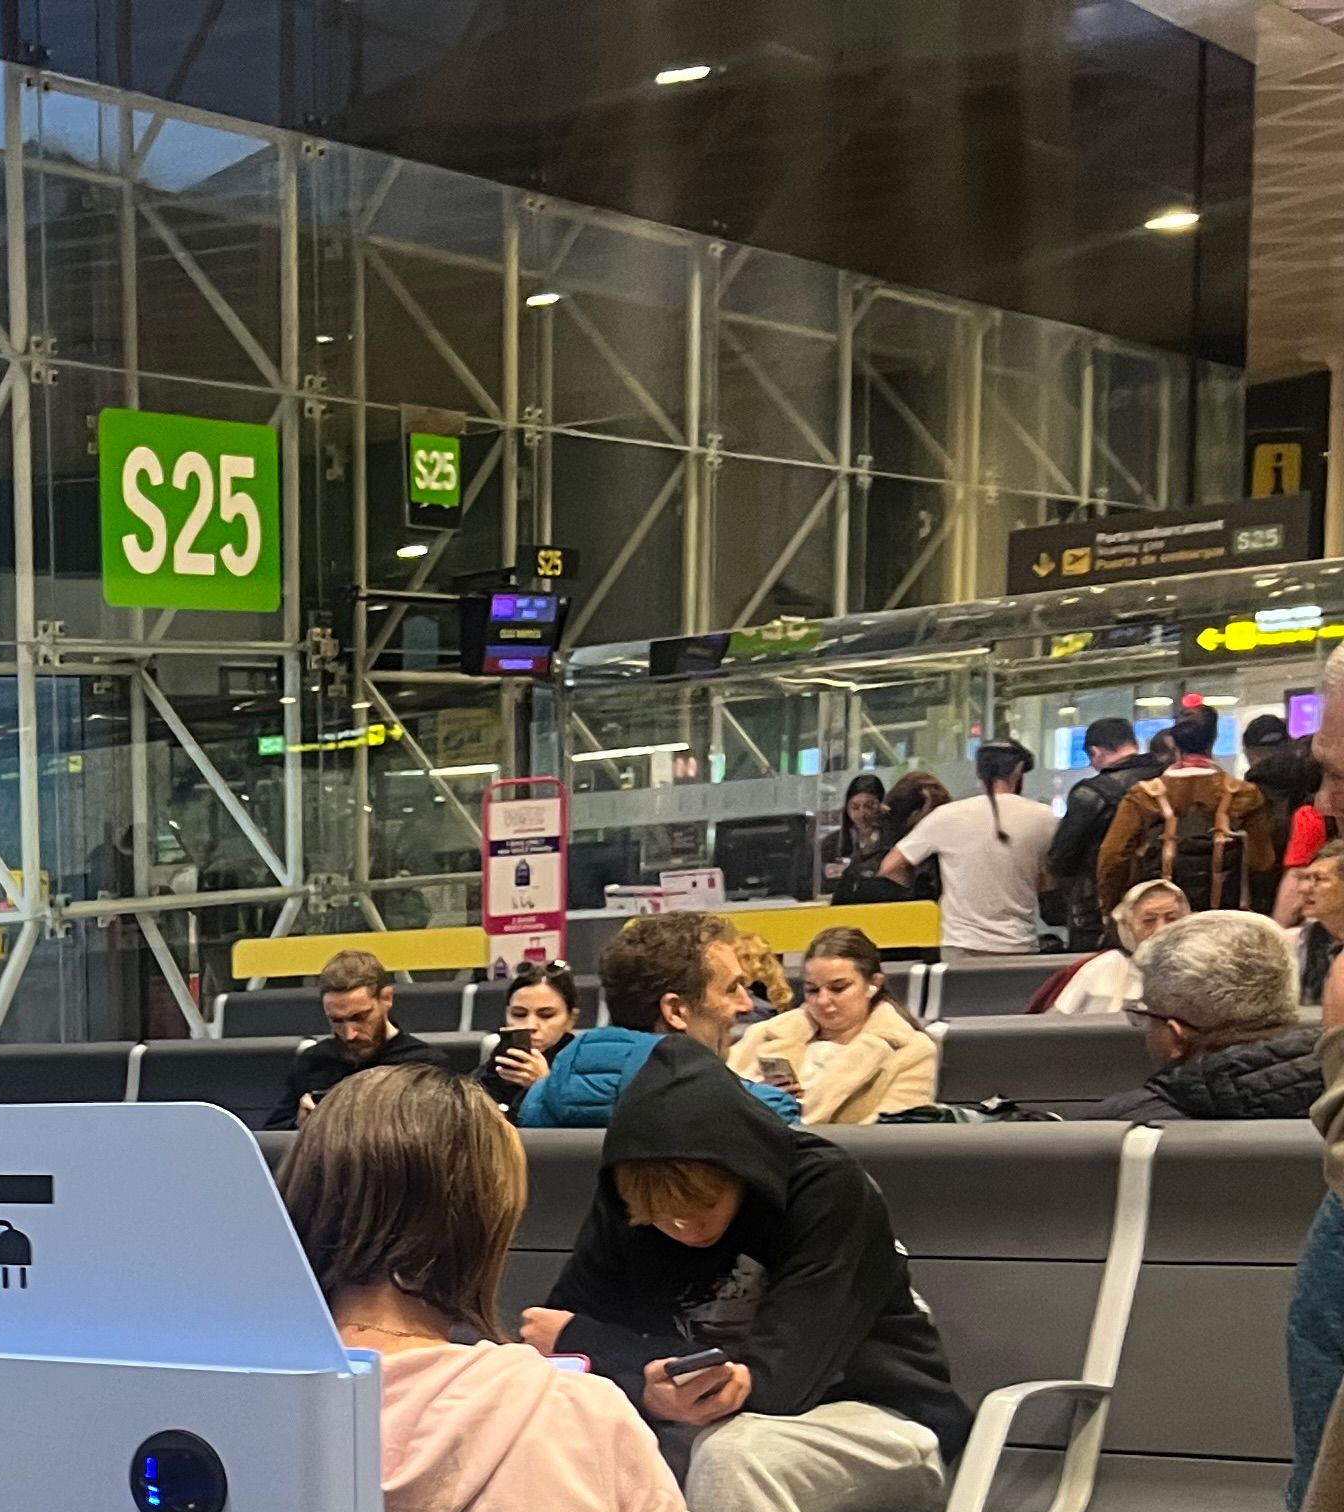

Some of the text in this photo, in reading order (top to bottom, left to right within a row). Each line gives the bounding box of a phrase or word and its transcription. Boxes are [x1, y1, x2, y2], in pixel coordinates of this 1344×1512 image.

[414, 449, 457, 491] S25
[121, 446, 262, 577] S25
[1236, 527, 1279, 551] S25
[537, 549, 563, 576] S25
